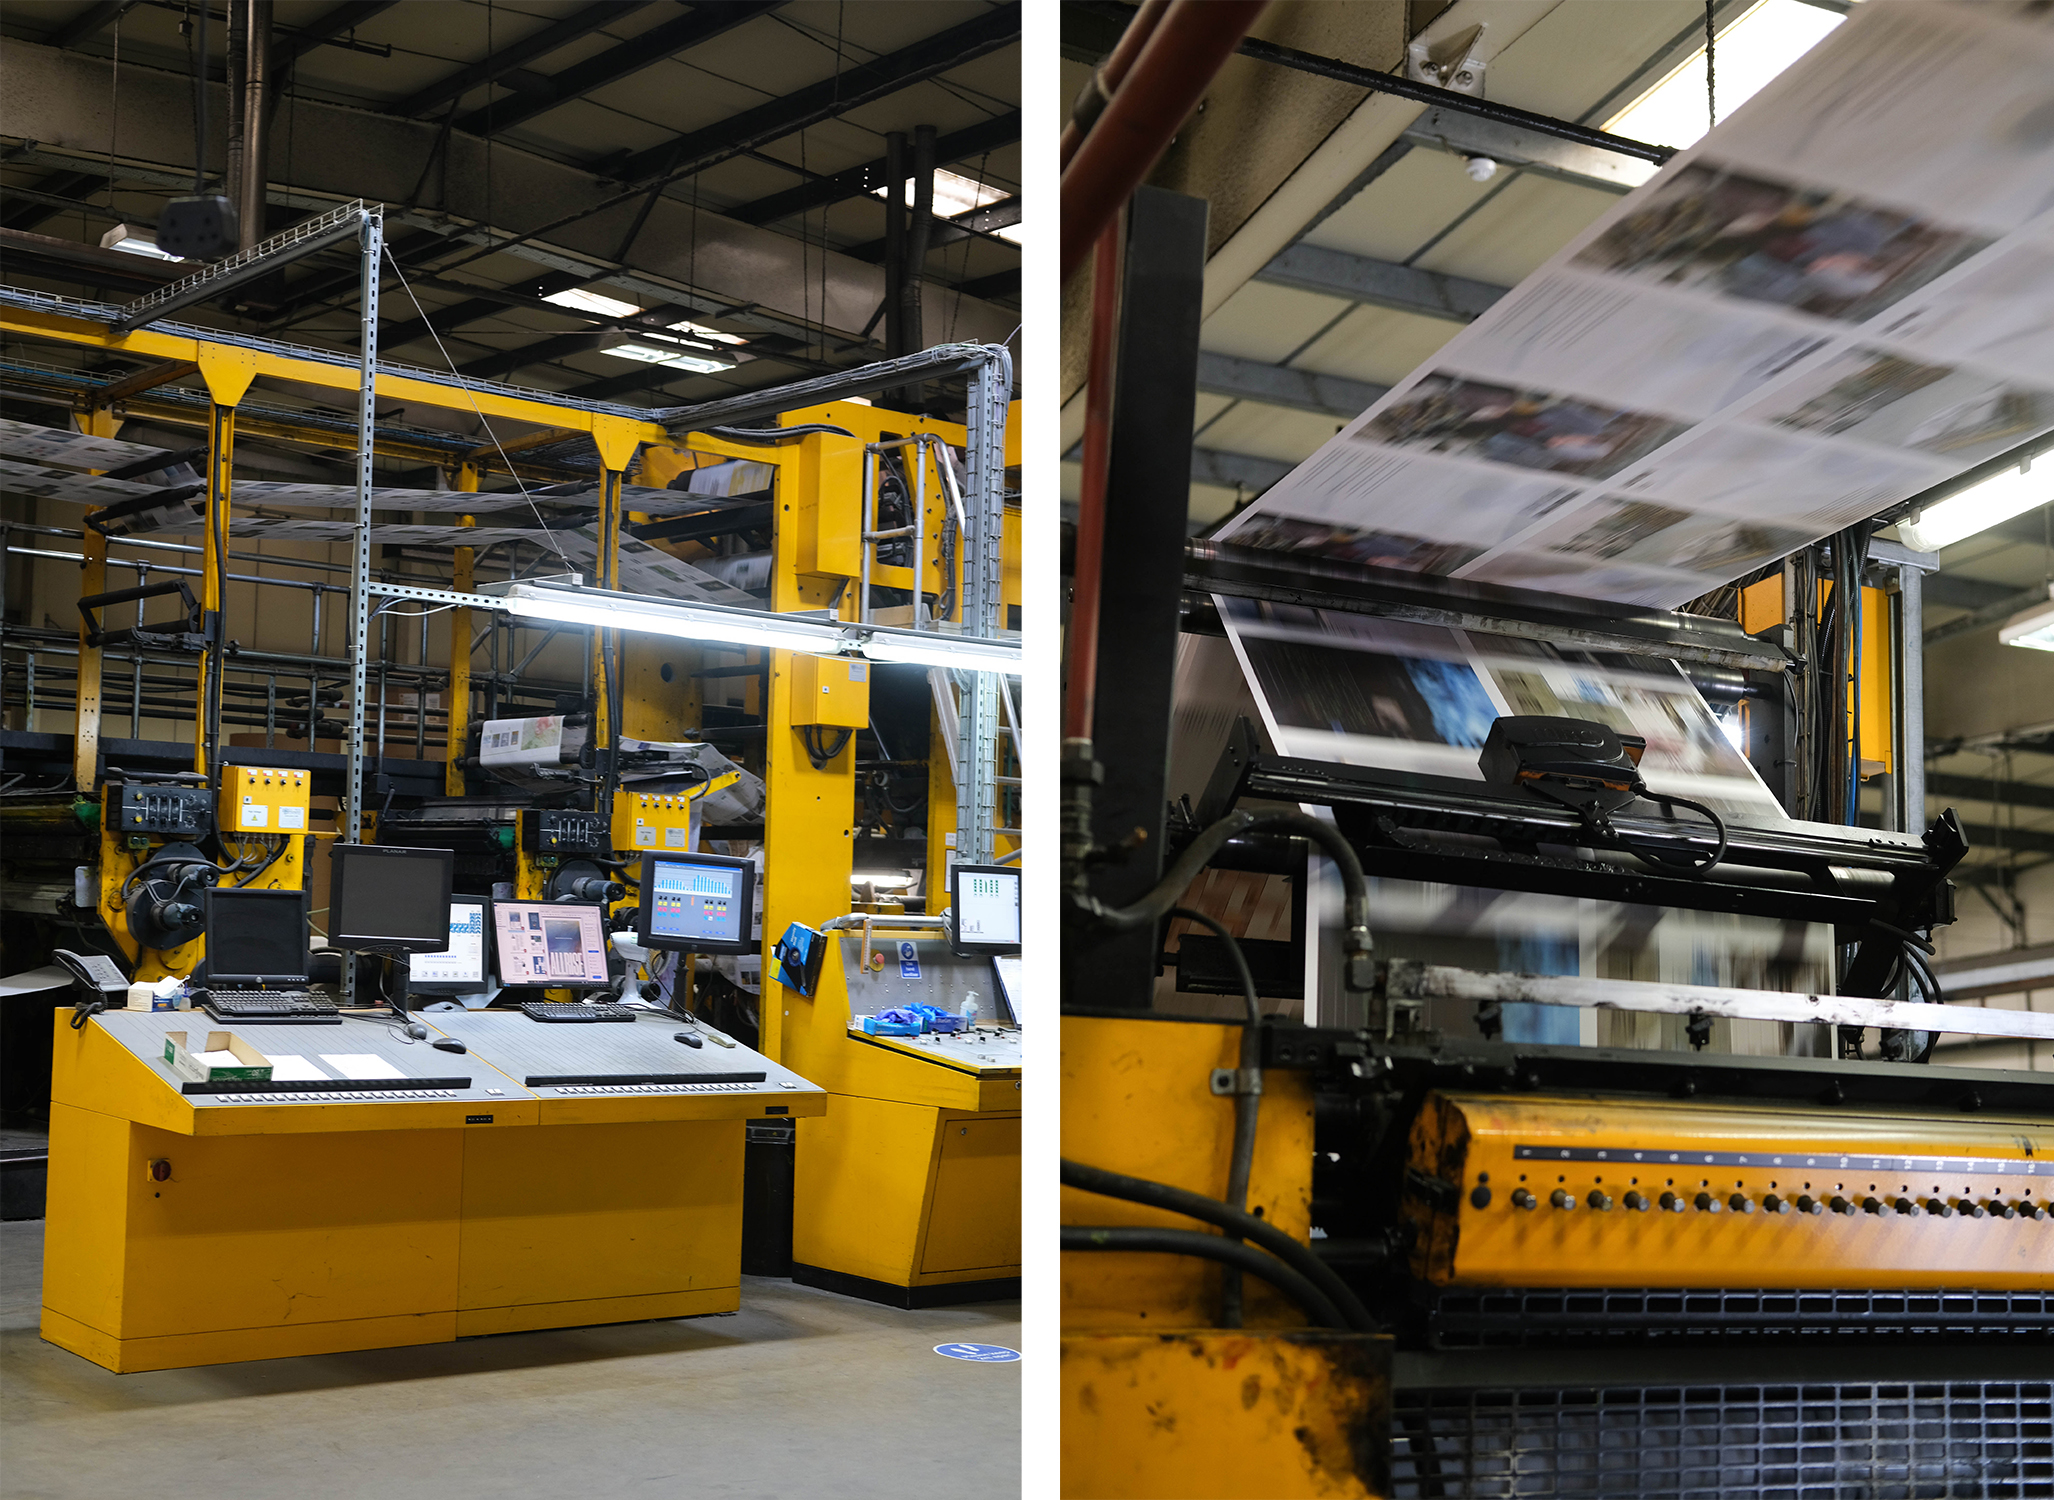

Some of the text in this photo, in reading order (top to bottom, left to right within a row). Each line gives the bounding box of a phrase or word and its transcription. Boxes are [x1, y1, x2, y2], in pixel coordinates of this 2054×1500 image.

[1560, 1149, 1571, 1159] 2
[1597, 1150, 1608, 1160] 3
[1634, 1152, 1643, 1161] 4
[1668, 1153, 1679, 1162] 5
[1704, 1154, 1714, 1163] 6
[1739, 1155, 1748, 1164] 7
[1773, 1156, 1783, 1165] 8
[1806, 1158, 1816, 1166] 9
[1840, 1156, 1849, 1169] 10
[1872, 1159, 1880, 1169] 11
[1904, 1159, 1913, 1170] 12
[1935, 1160, 1944, 1171] 13
[1967, 1161, 1975, 1172] 14
[1997, 1162, 2006, 1173] 15
[2027, 1163, 2036, 1174] 16
